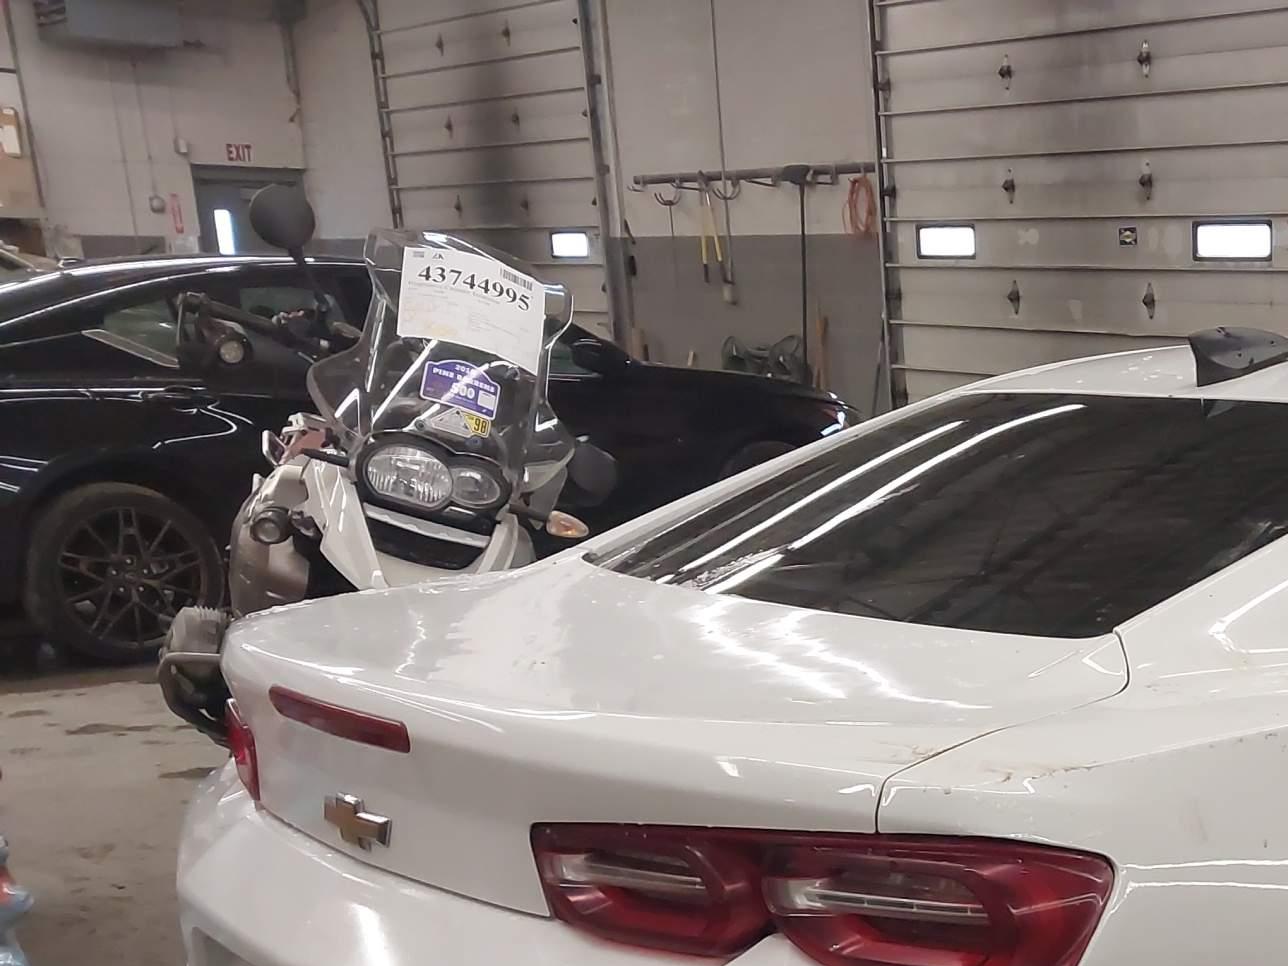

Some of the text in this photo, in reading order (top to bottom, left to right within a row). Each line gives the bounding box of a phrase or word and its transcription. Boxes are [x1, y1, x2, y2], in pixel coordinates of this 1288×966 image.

[226, 143, 252, 162] EXIT
[418, 265, 531, 311] 43744995
[450, 382, 476, 399] 500
